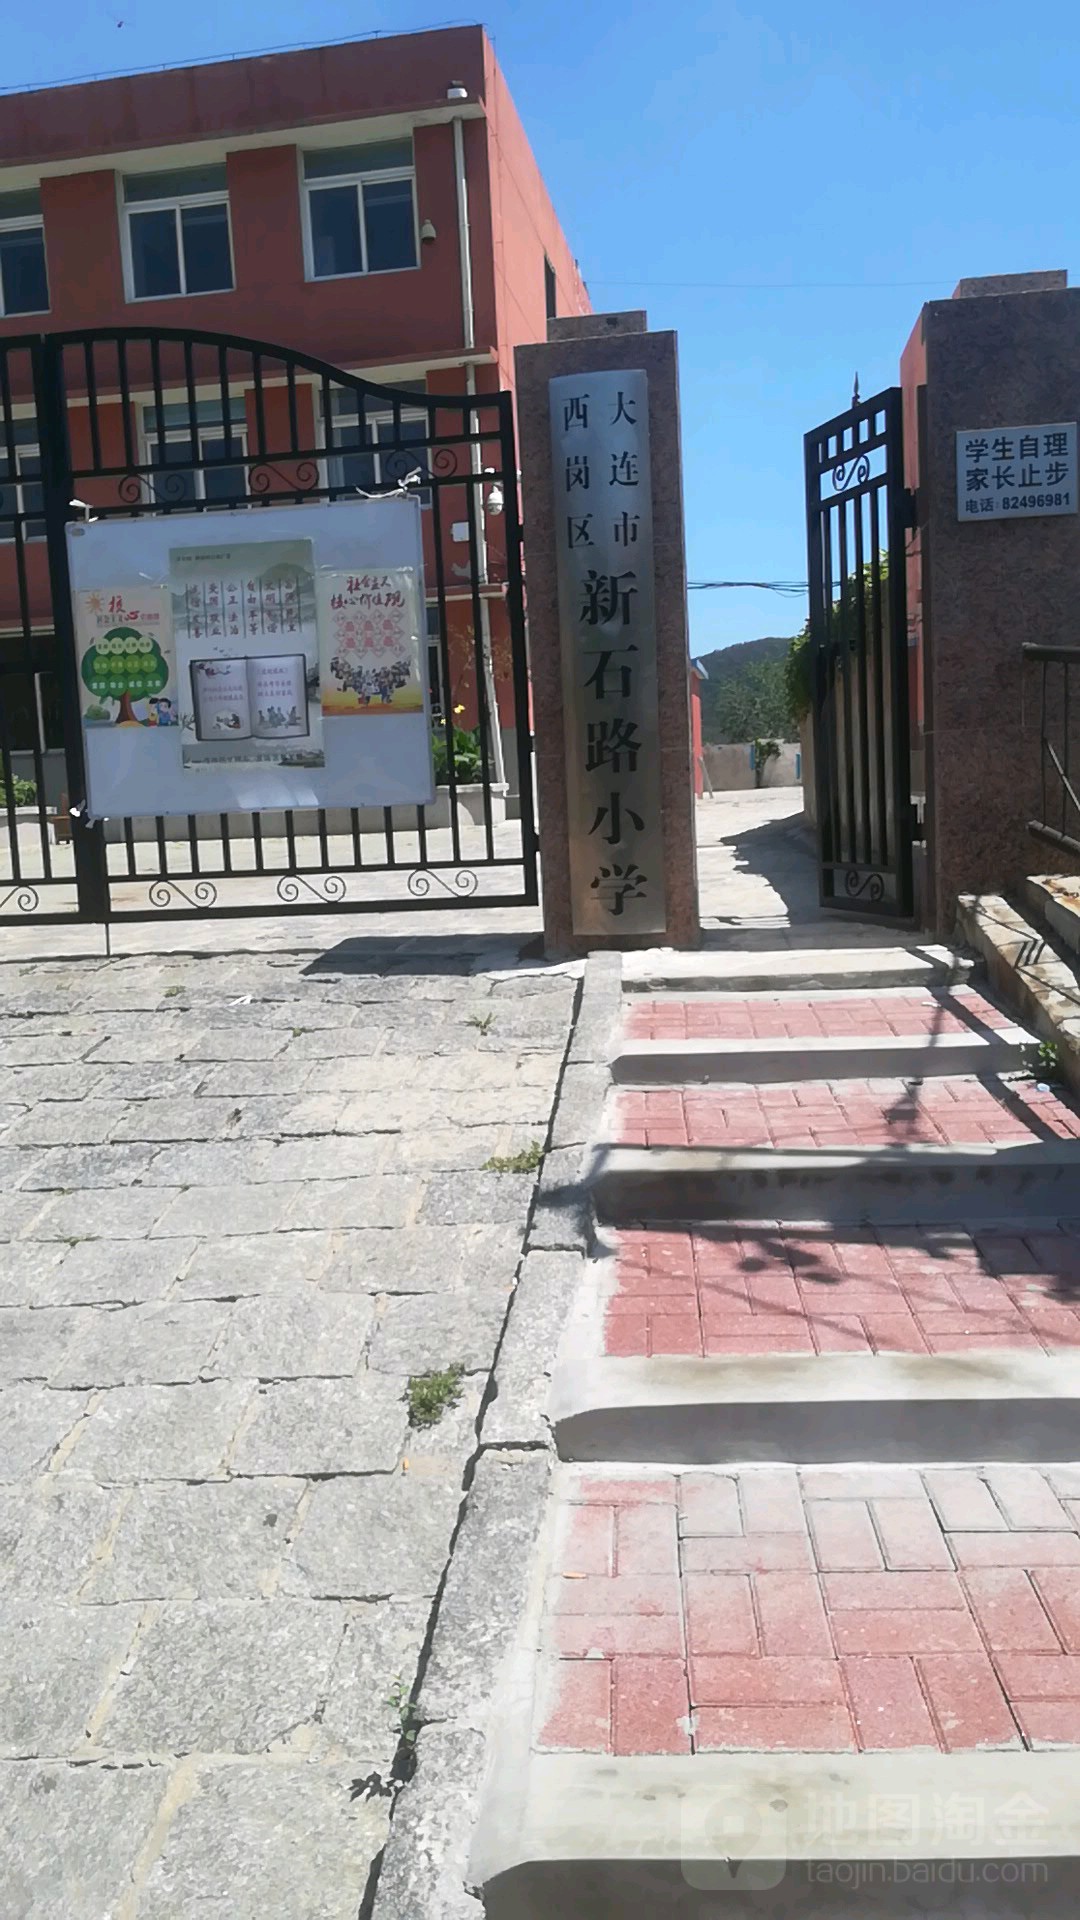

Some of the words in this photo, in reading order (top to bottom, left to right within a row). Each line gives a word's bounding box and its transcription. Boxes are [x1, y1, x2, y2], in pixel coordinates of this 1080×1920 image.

[563, 394, 595, 550] 西岗区
[608, 391, 641, 547] 大连市
[965, 432, 1069, 463] 学生自理
[966, 461, 1069, 491] 家长止步
[579, 569, 648, 917] 新石路小学
